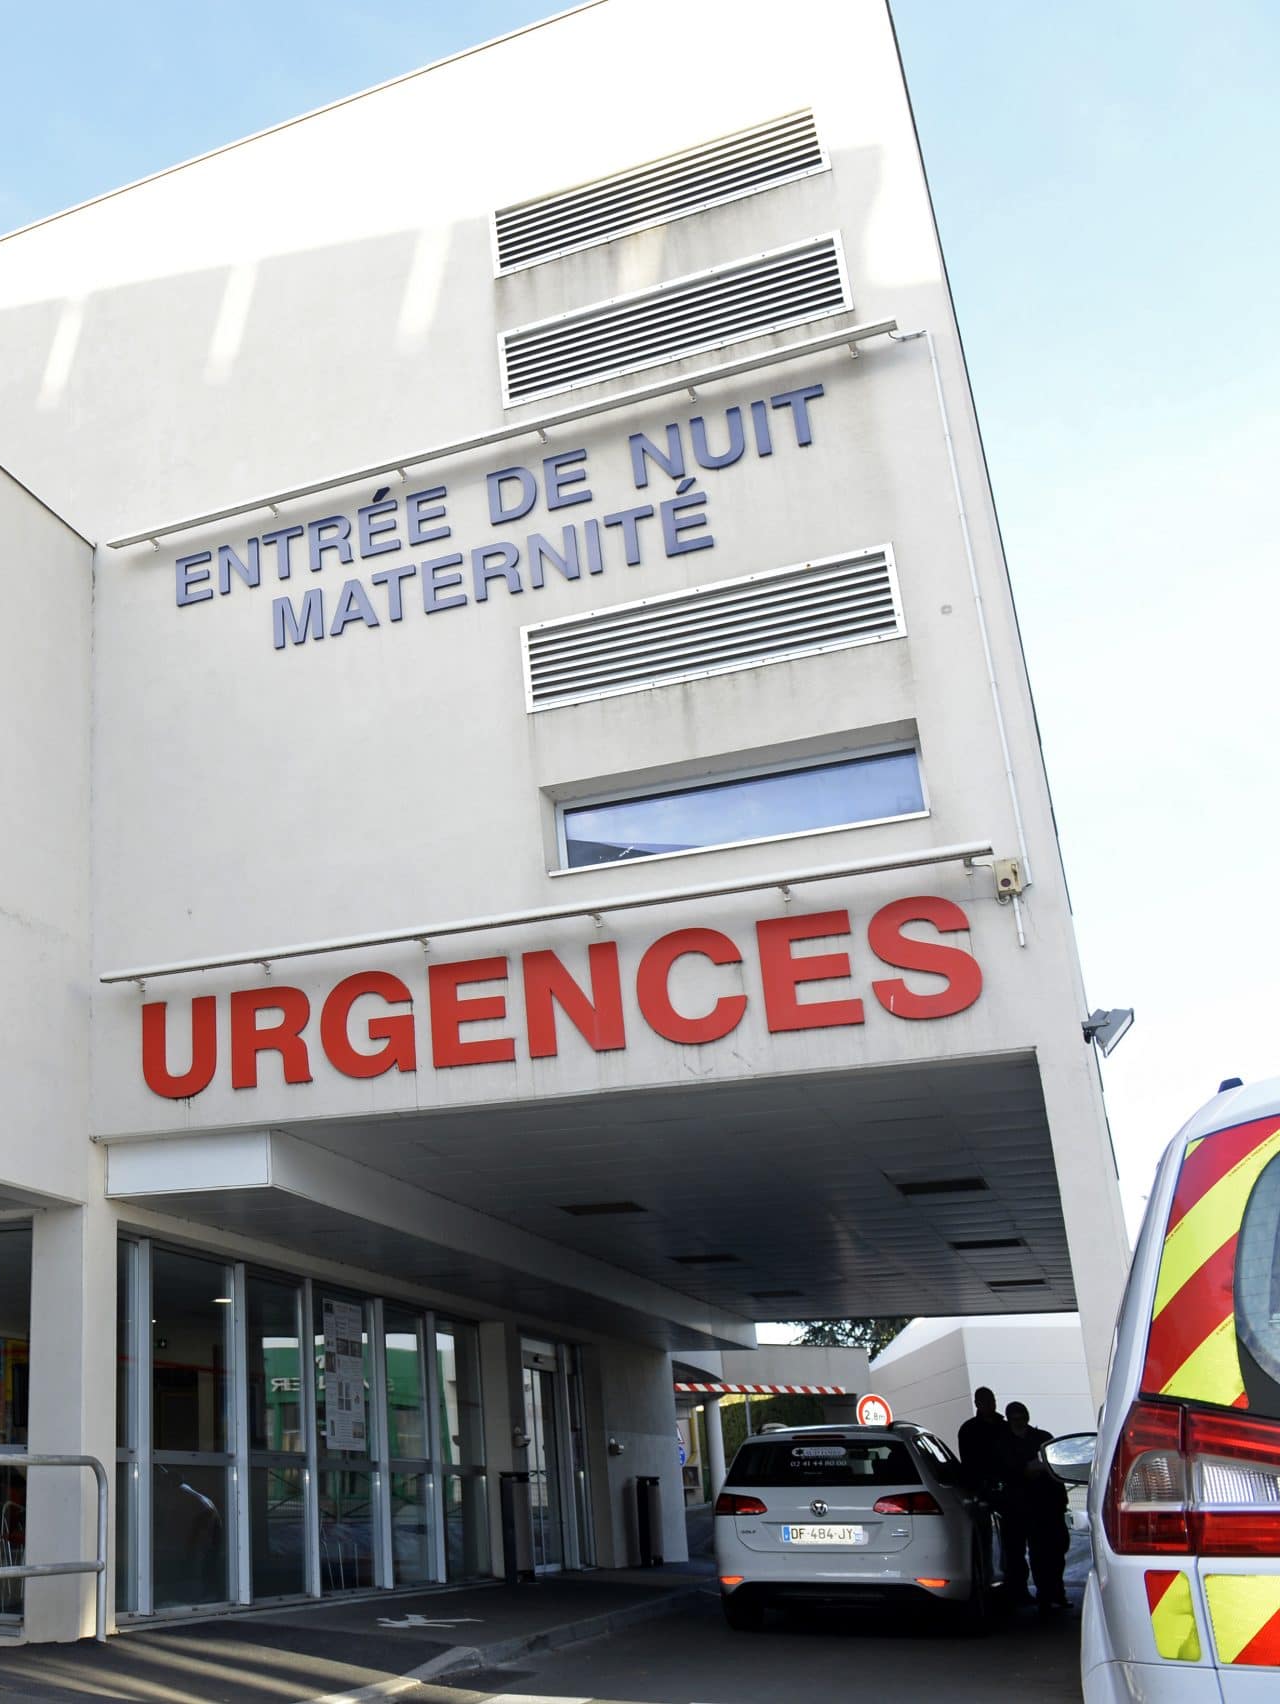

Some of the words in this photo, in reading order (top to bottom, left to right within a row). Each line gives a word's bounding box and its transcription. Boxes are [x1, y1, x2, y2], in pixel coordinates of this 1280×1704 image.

[176, 486, 451, 607] ENTRÉE
[486, 448, 593, 526] DE
[628, 384, 824, 488] NUIT
[272, 477, 714, 649] MATERNITÉ
[142, 896, 983, 1099] URGENCES
[791, 1528, 853, 1539] DF-484-JY
